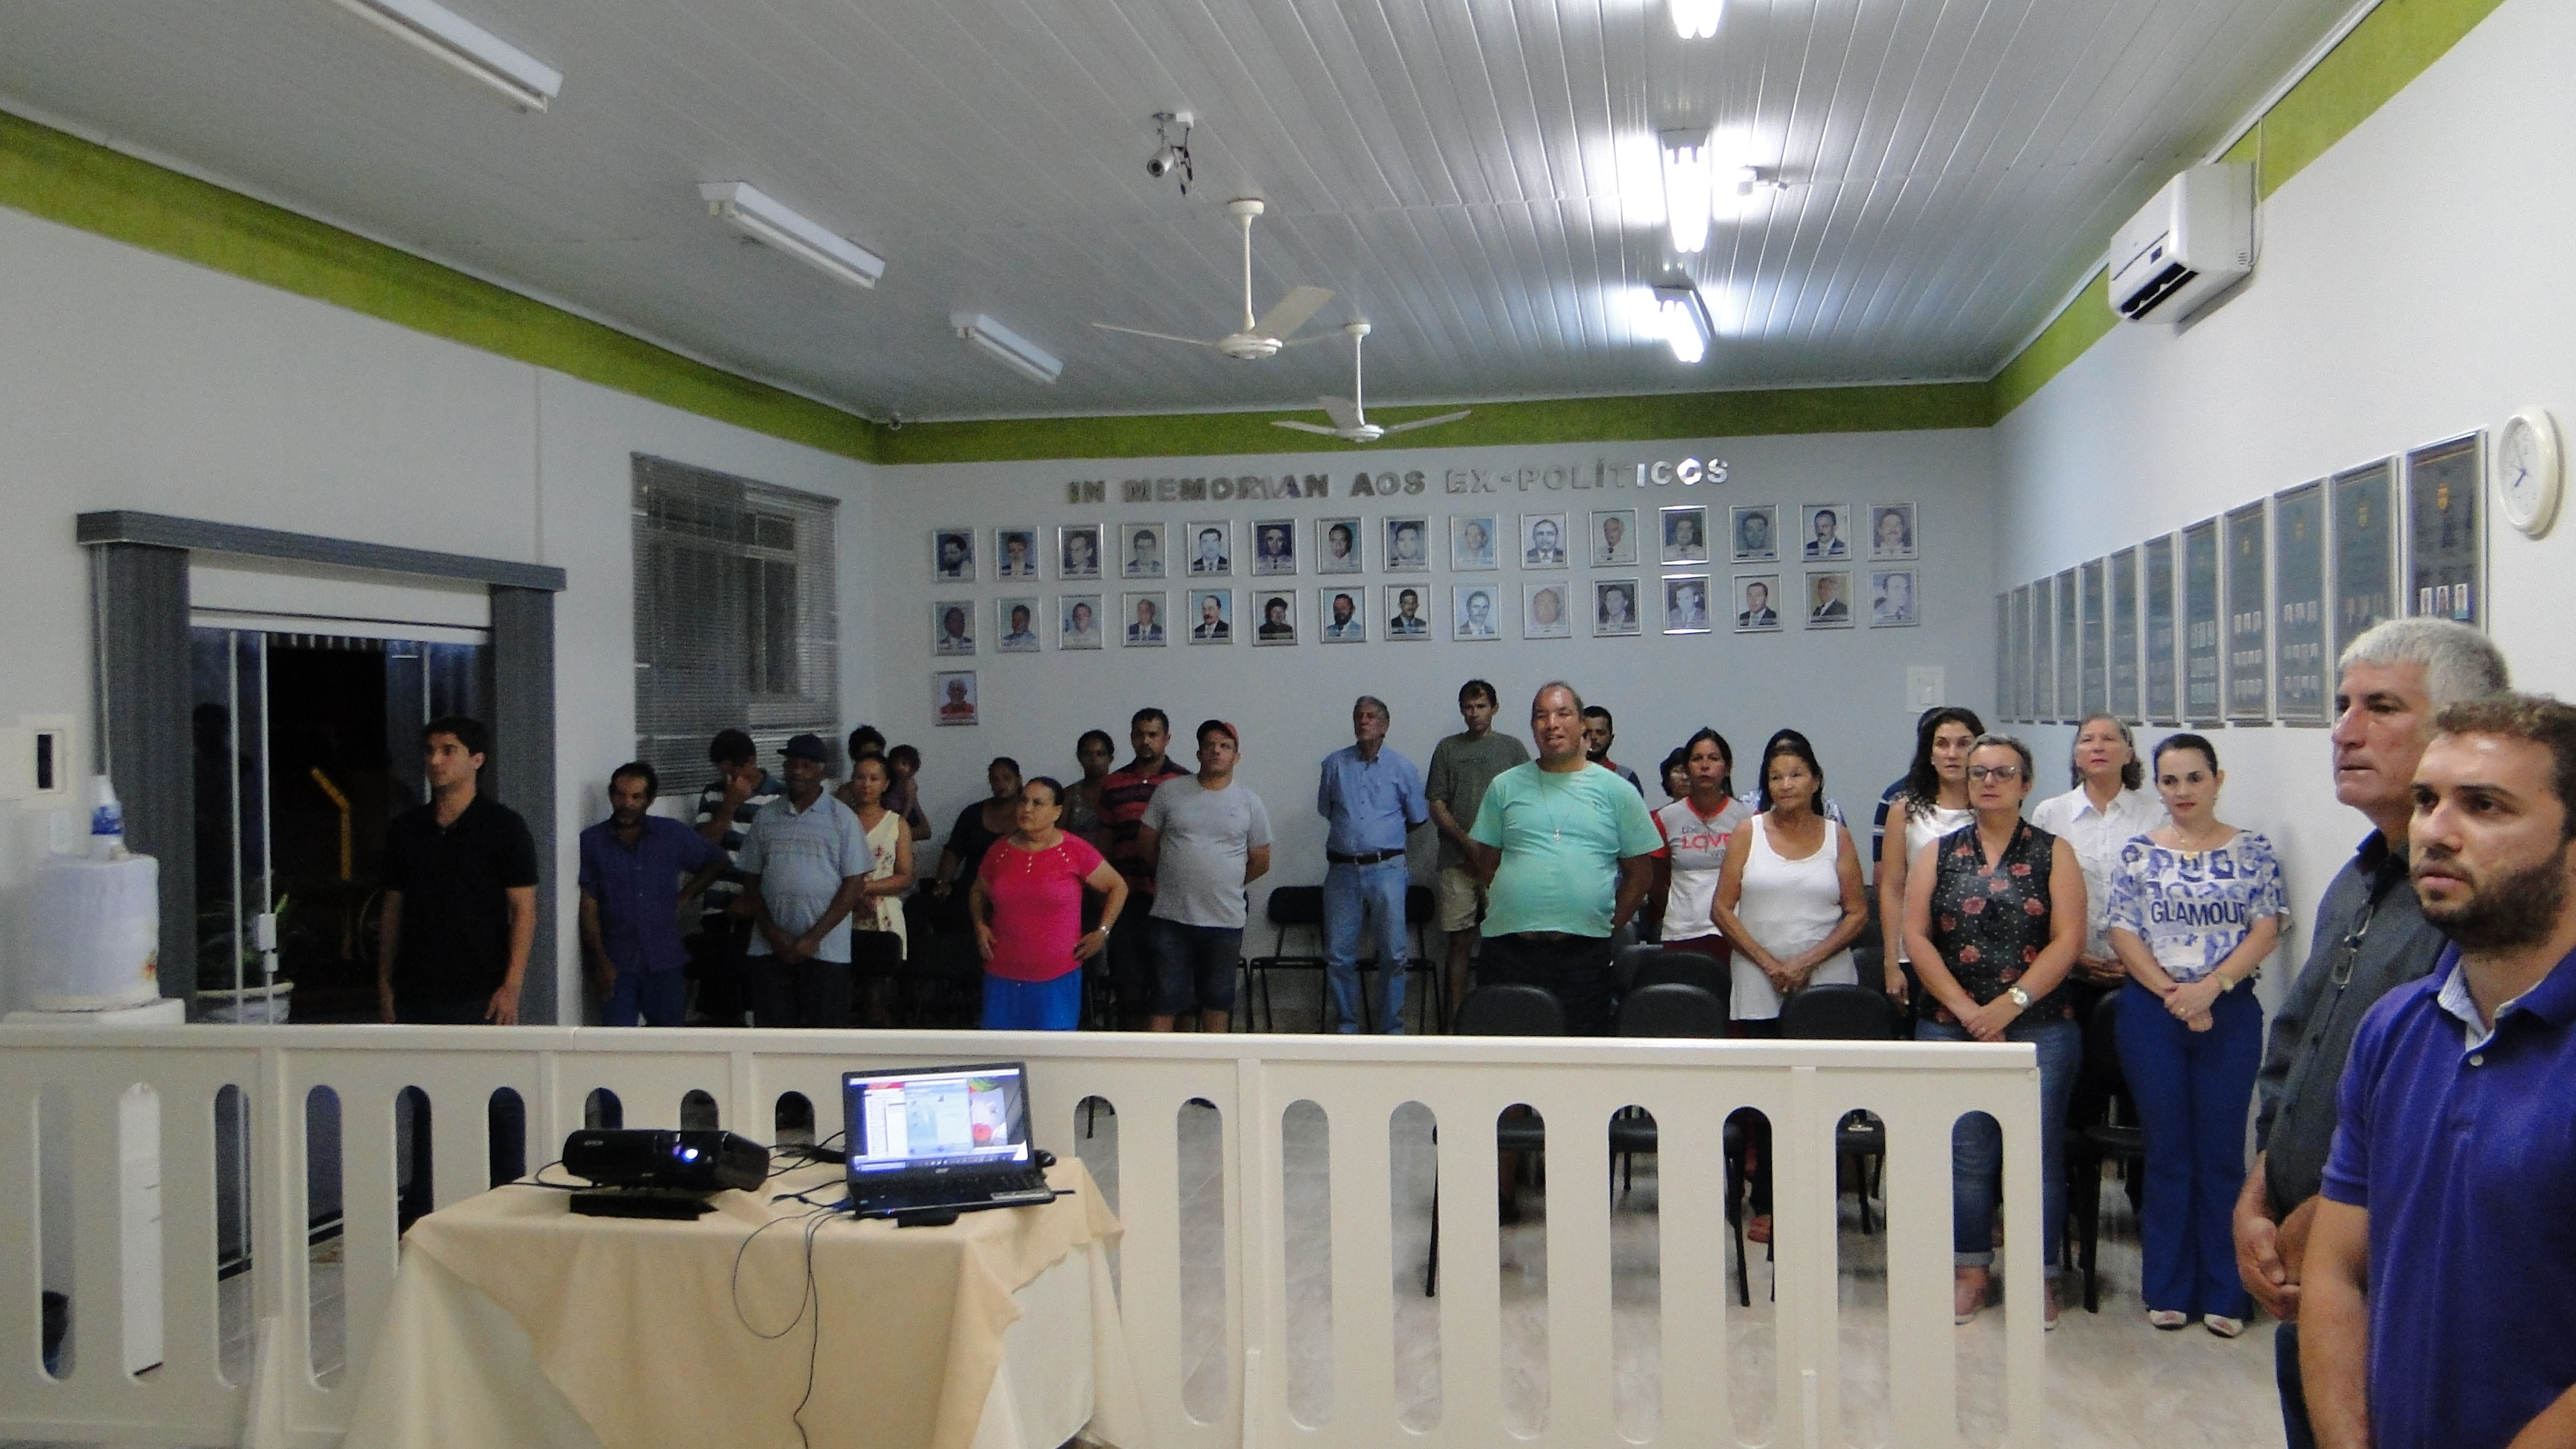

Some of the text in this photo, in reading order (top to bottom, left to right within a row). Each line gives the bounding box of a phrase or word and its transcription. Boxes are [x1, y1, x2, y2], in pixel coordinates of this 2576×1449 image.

[1067, 480, 1106, 504] IN
[1123, 473, 1329, 503] MEMORIAN
[1350, 470, 1425, 498] AOS
